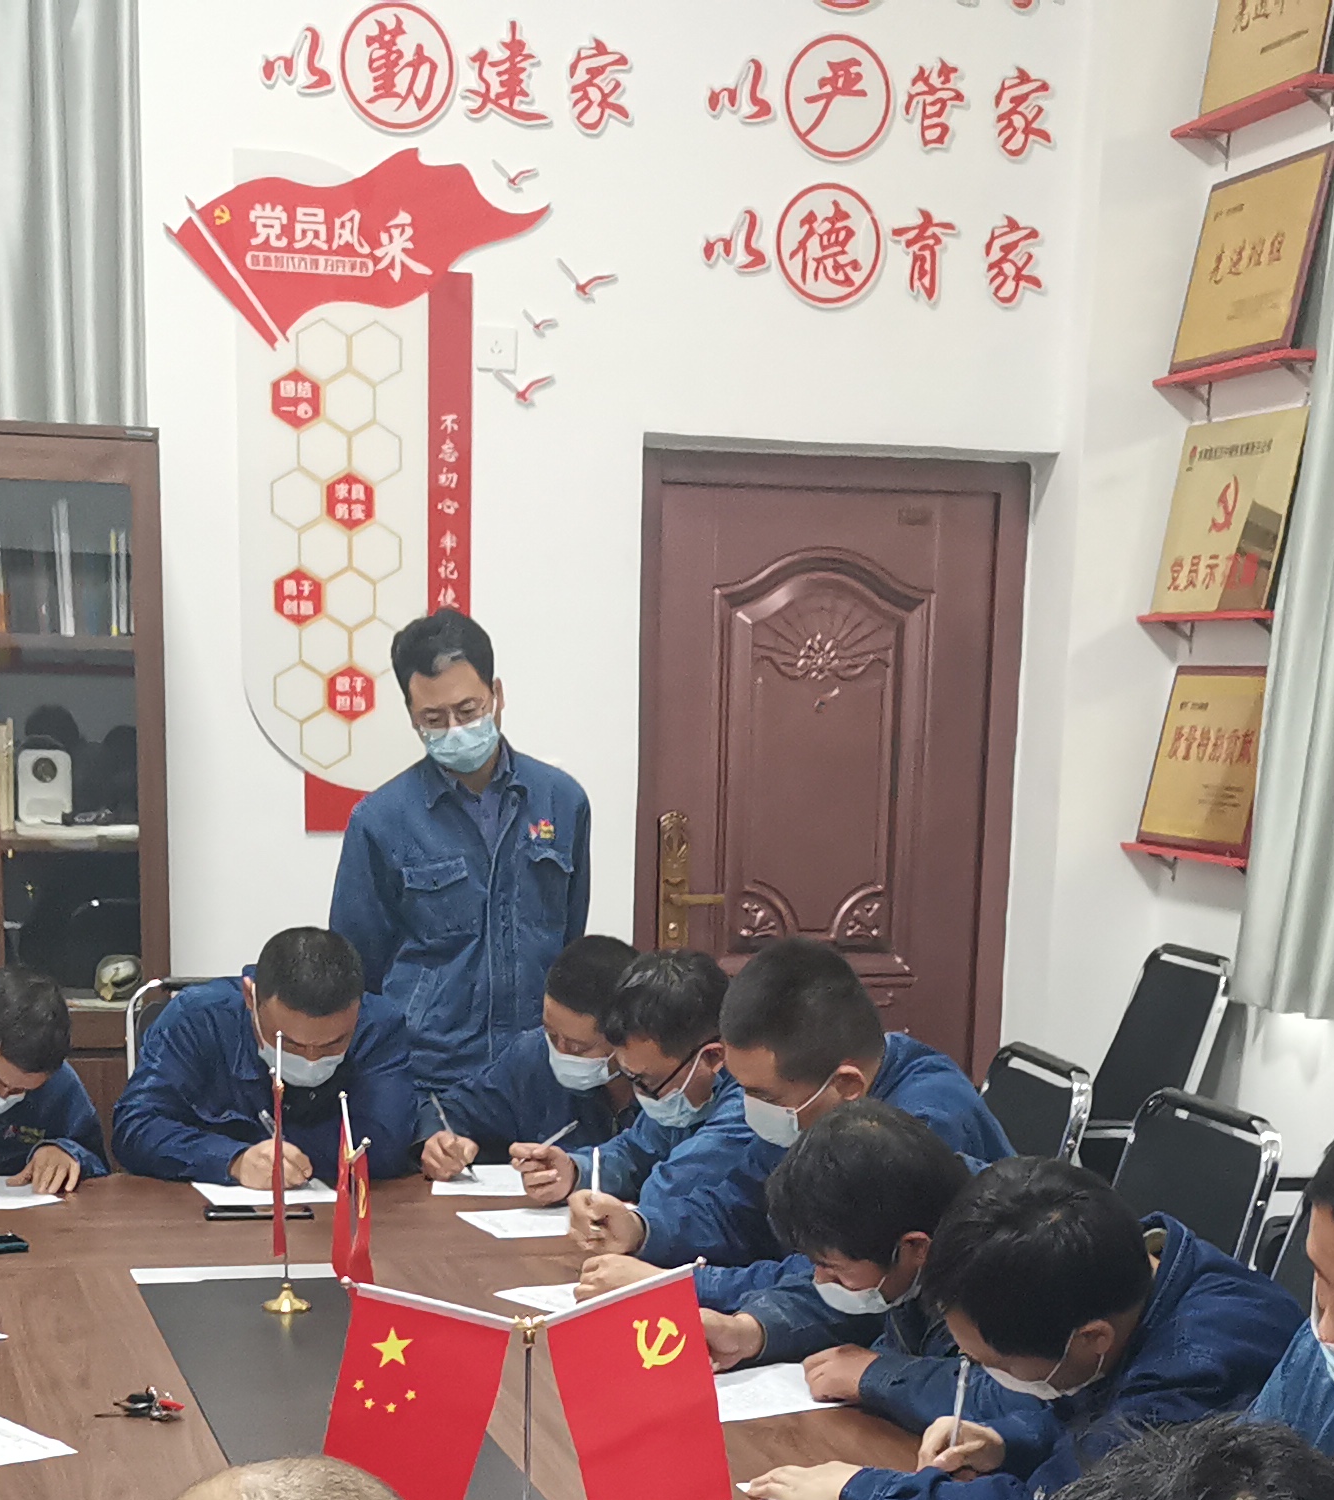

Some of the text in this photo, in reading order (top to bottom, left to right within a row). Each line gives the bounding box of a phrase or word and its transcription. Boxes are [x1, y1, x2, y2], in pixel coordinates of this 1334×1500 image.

[263, 3, 629, 130] 以勤建家
[708, 34, 1051, 158] 以严管家
[249, 202, 433, 283] 党员风采
[704, 183, 1042, 304] 以德育家
[280, 401, 313, 419] 一心
[437, 413, 460, 515] 不忘初心
